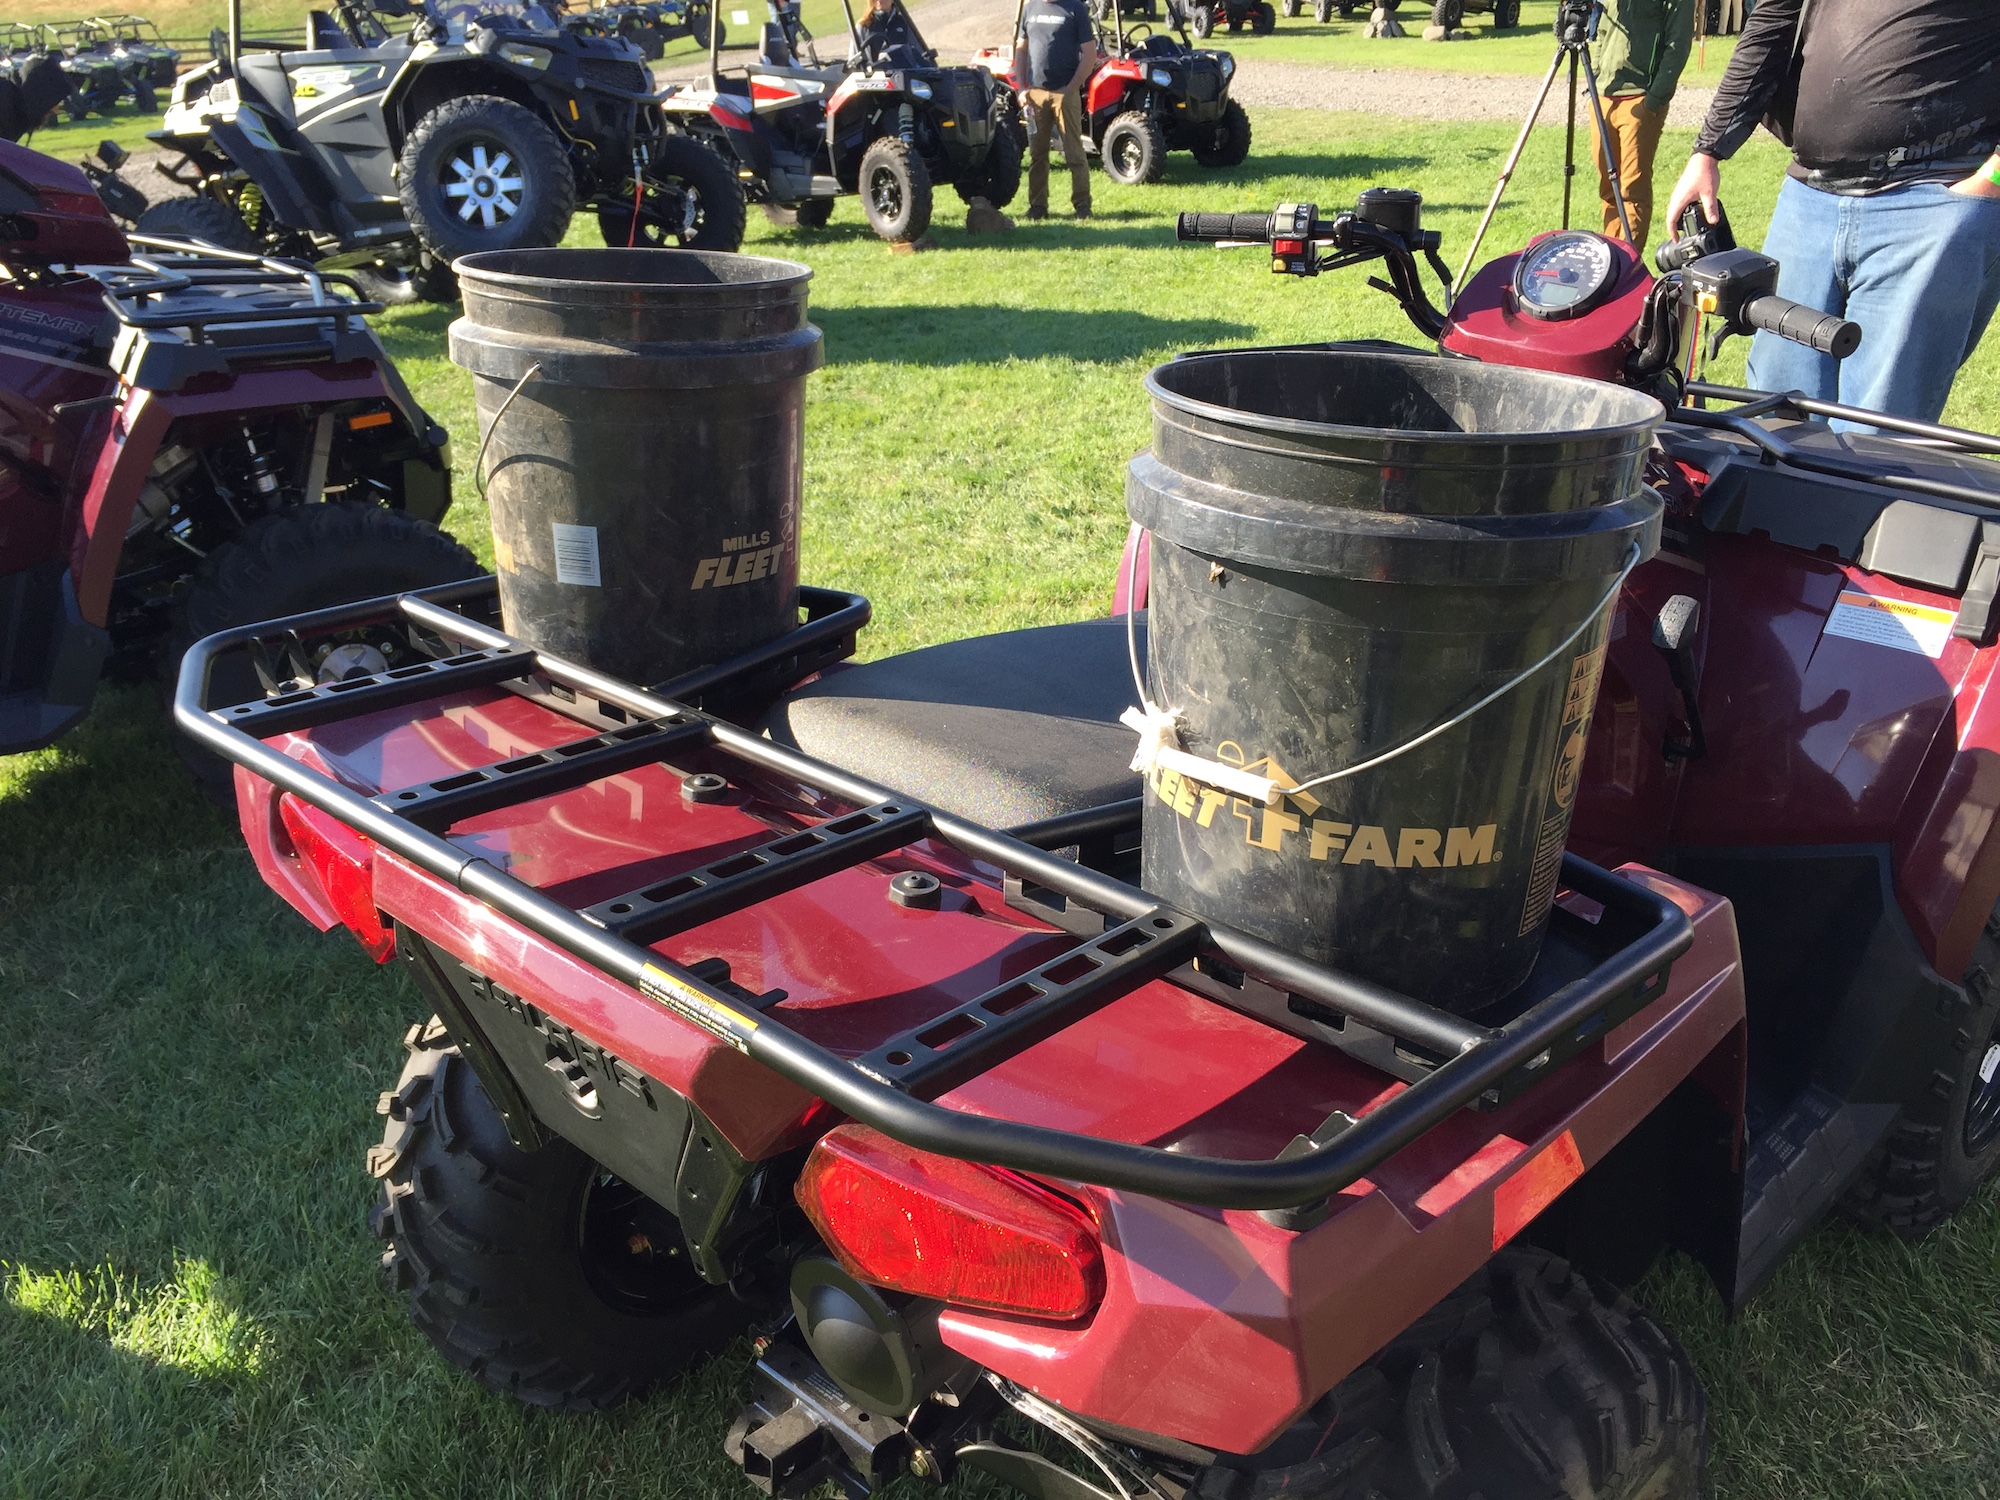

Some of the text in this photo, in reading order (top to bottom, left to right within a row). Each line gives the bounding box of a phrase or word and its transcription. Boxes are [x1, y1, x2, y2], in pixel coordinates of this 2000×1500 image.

[293, 84, 317, 97] XC
[722, 530, 771, 553] MILLS
[690, 542, 785, 591] FLEET
[1876, 601, 1918, 616] WARNING
[1149, 765, 1228, 829] LEET
[1309, 818, 1498, 868] FARM
[685, 985, 718, 1009] WARNING
[460, 962, 649, 1098] POLARIS
